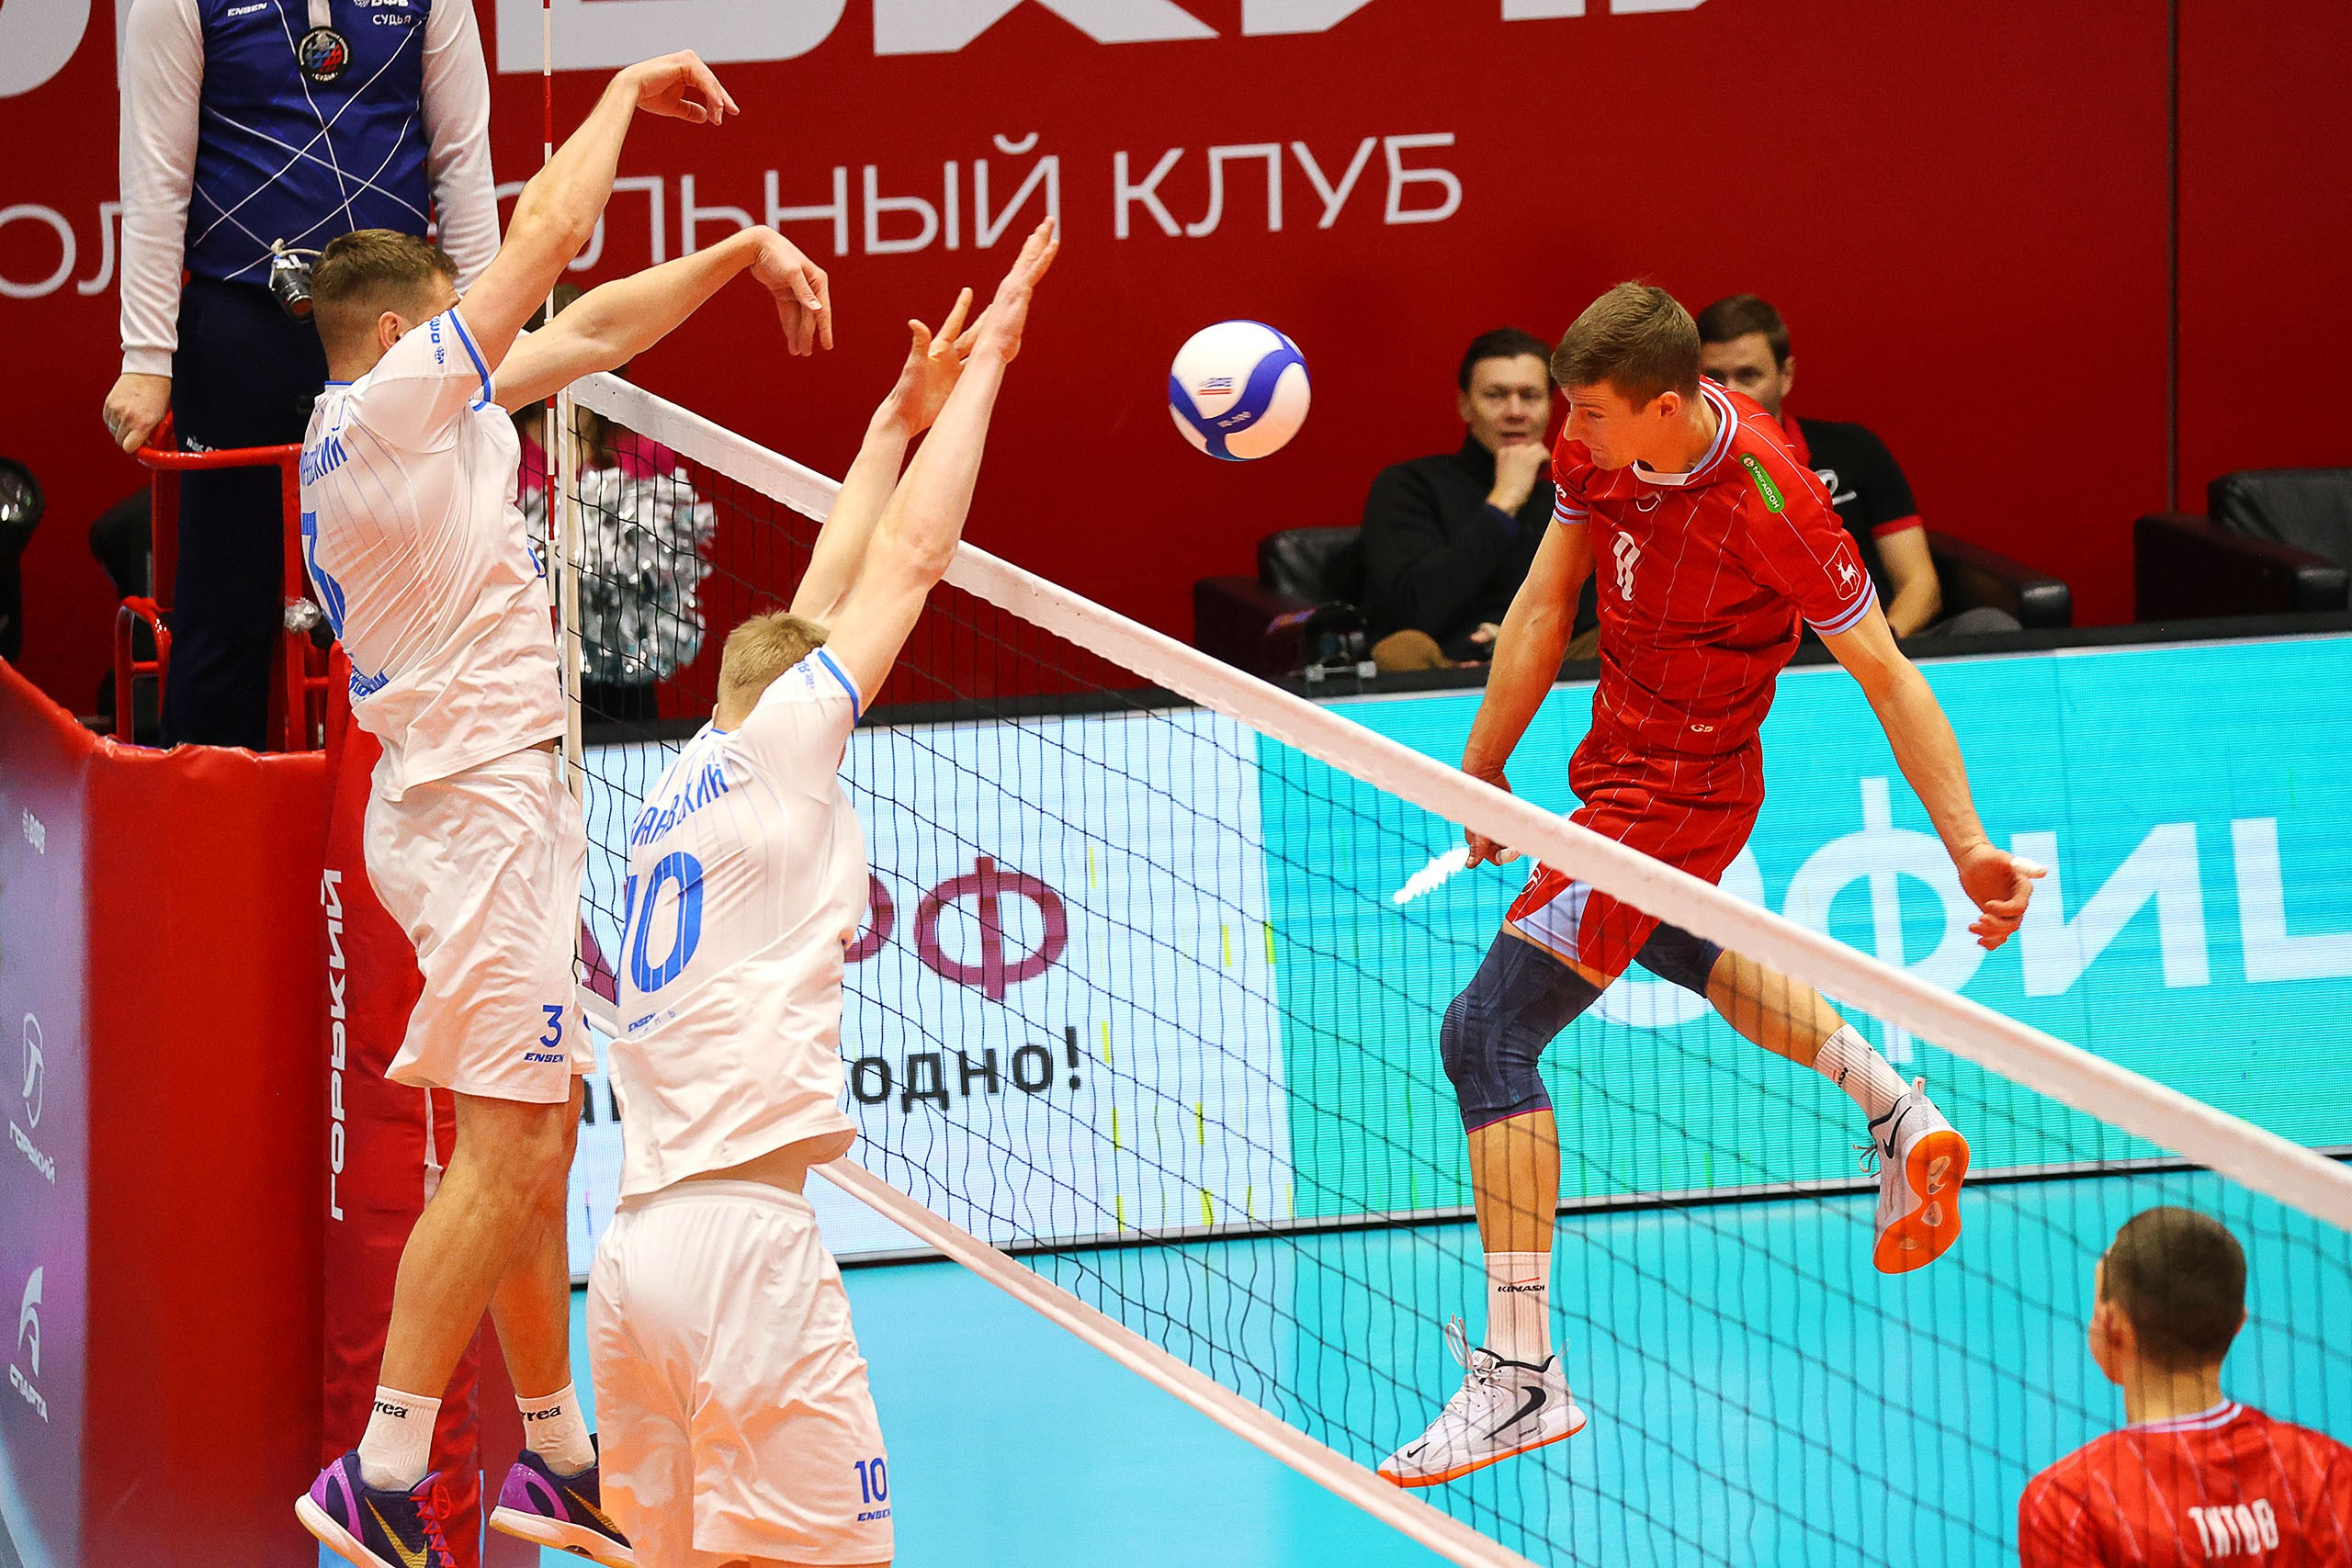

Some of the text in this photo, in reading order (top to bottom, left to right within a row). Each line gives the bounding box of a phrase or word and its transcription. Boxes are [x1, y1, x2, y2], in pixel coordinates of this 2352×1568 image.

[372, 14, 413, 26] СУДЬЯ
[1114, 131, 1464, 240] КЛУБ
[320, 868, 346, 1222] ГОРЬКИЙ
[539, 1004, 563, 1048] 3
[524, 1052, 565, 1064] ENSEN
[851, 1026, 1082, 1114] одно!
[1498, 1284, 1545, 1292] KINASH
[854, 1457, 888, 1504] 10
[2188, 1498, 2279, 1559] ТИТОВ
